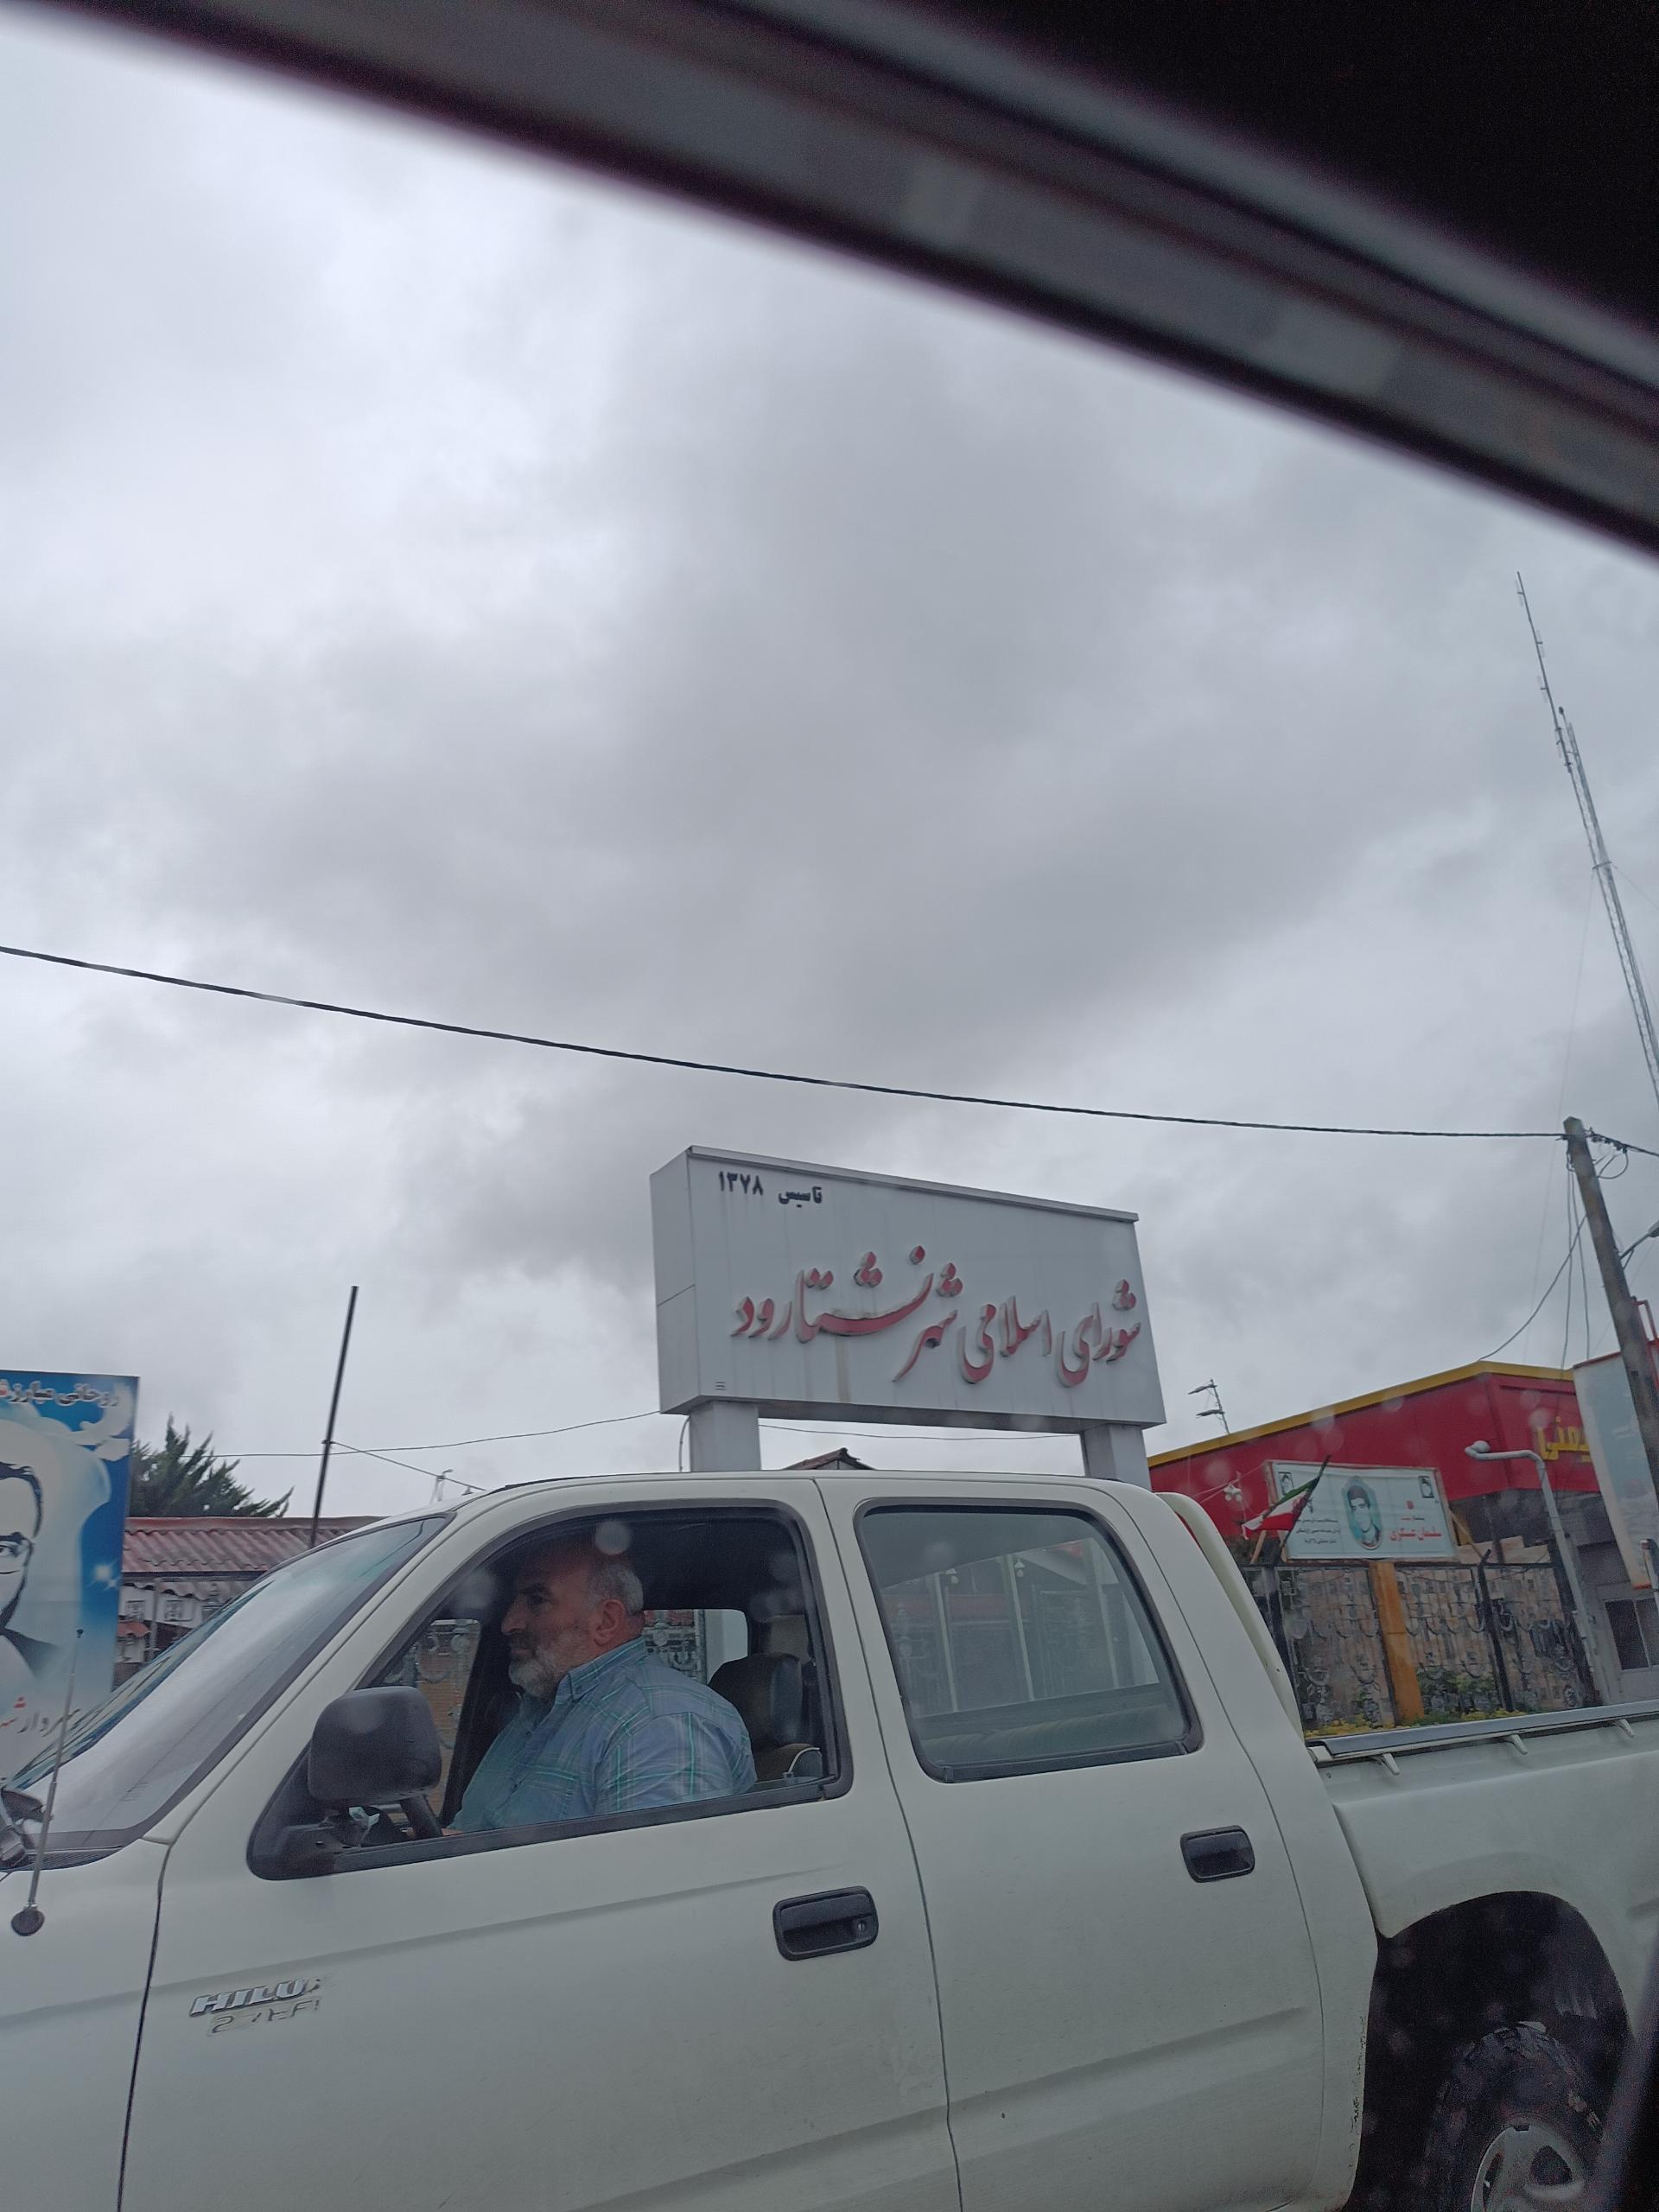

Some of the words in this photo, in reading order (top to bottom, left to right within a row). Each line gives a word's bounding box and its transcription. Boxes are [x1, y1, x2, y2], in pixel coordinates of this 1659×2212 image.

[718, 1171, 764, 1196] ۱۳۷۸
[778, 1185, 823, 1209] تاسیس
[730, 1245, 935, 1344] نشتارود
[892, 1262, 964, 1383] شهر
[957, 1294, 1053, 1385] اسلامی
[1054, 1279, 1142, 1389] شورای
